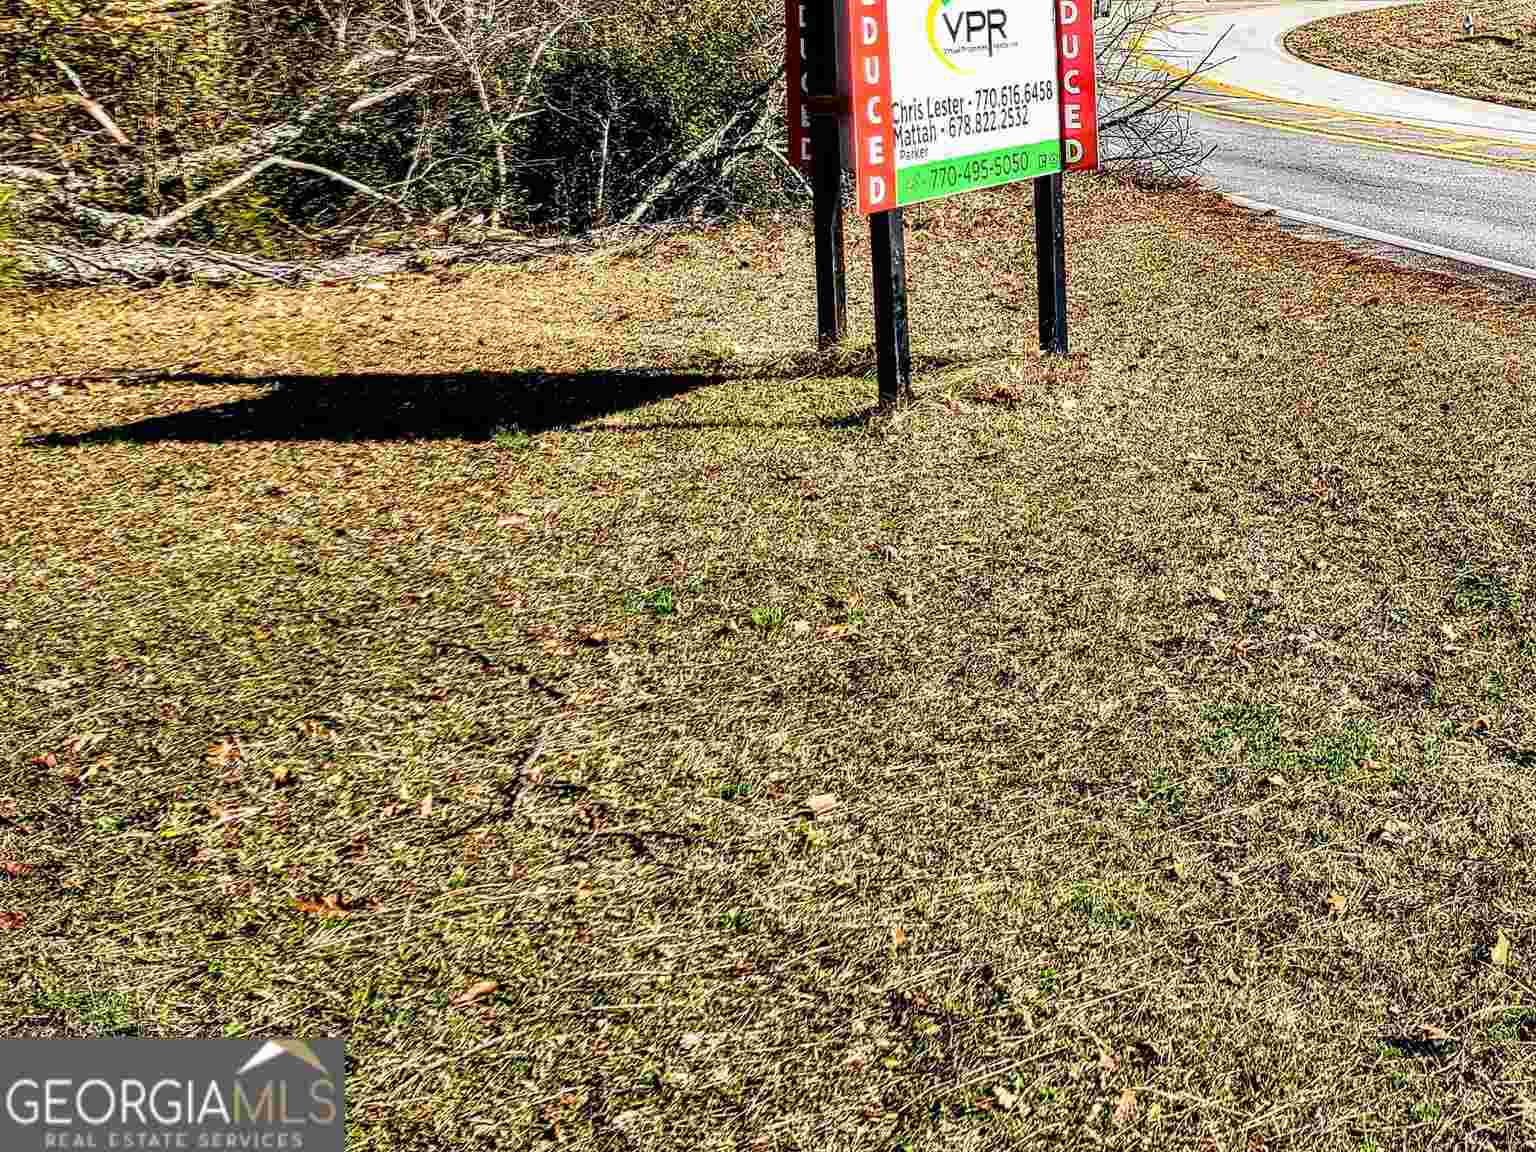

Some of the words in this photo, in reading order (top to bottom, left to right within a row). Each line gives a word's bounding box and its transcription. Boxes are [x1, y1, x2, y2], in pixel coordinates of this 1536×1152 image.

[942, 9, 1008, 57] VPR
[892, 98, 924, 126] Chris
[927, 97, 964, 119] Lester
[976, 80, 1053, 111] 770.616.6458
[949, 105, 1029, 138] 678.822.2532
[930, 151, 1030, 190] 770-495-5050
